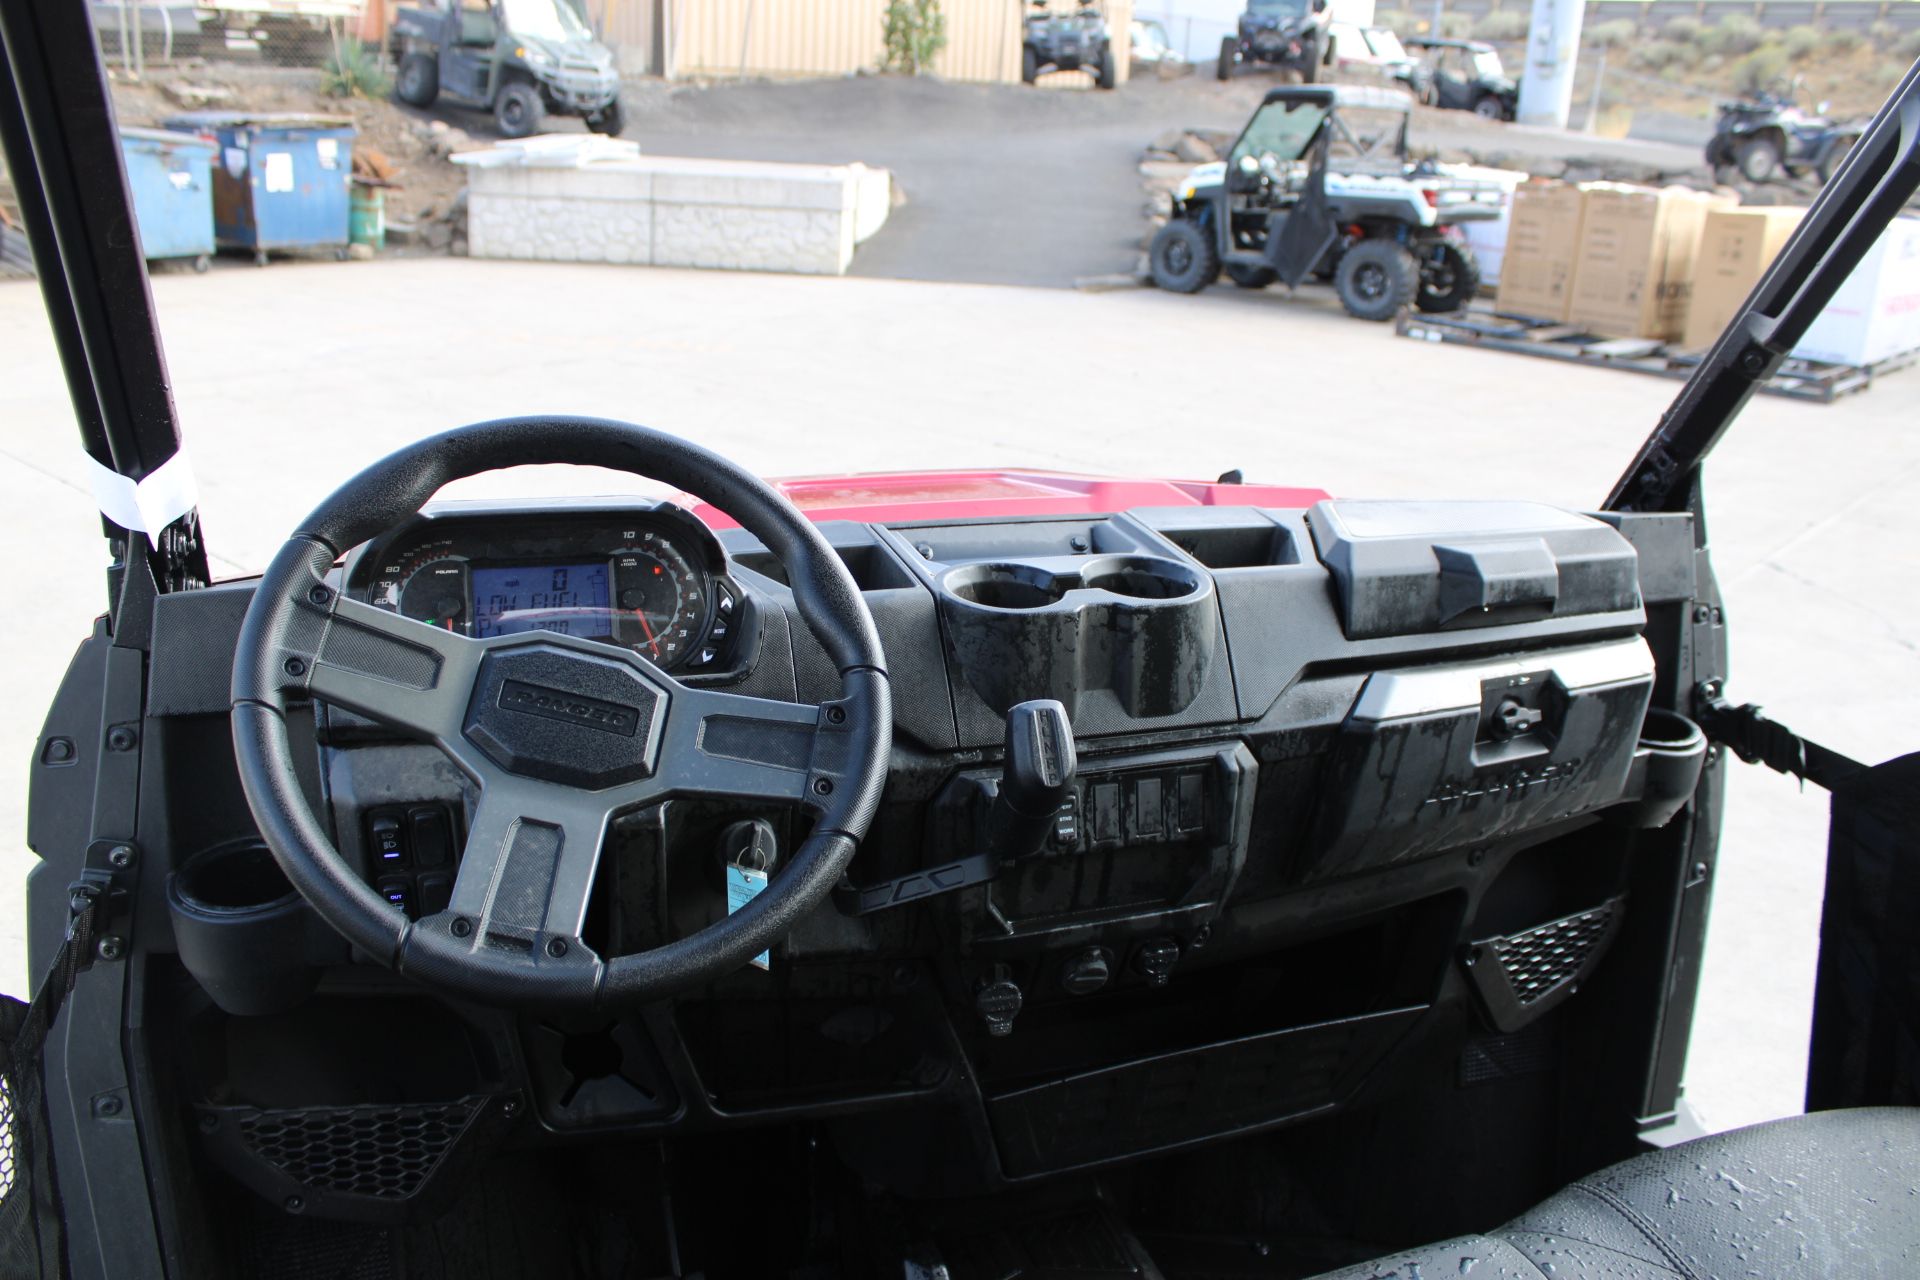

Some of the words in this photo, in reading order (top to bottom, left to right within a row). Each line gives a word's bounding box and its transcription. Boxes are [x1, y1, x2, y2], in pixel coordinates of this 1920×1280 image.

[623, 531, 636, 539] 10
[552, 568, 568, 592] 0
[689, 592, 697, 600] 5
[686, 612, 695, 620] 4
[679, 629, 688, 638] 3
[667, 643, 676, 651] 2
